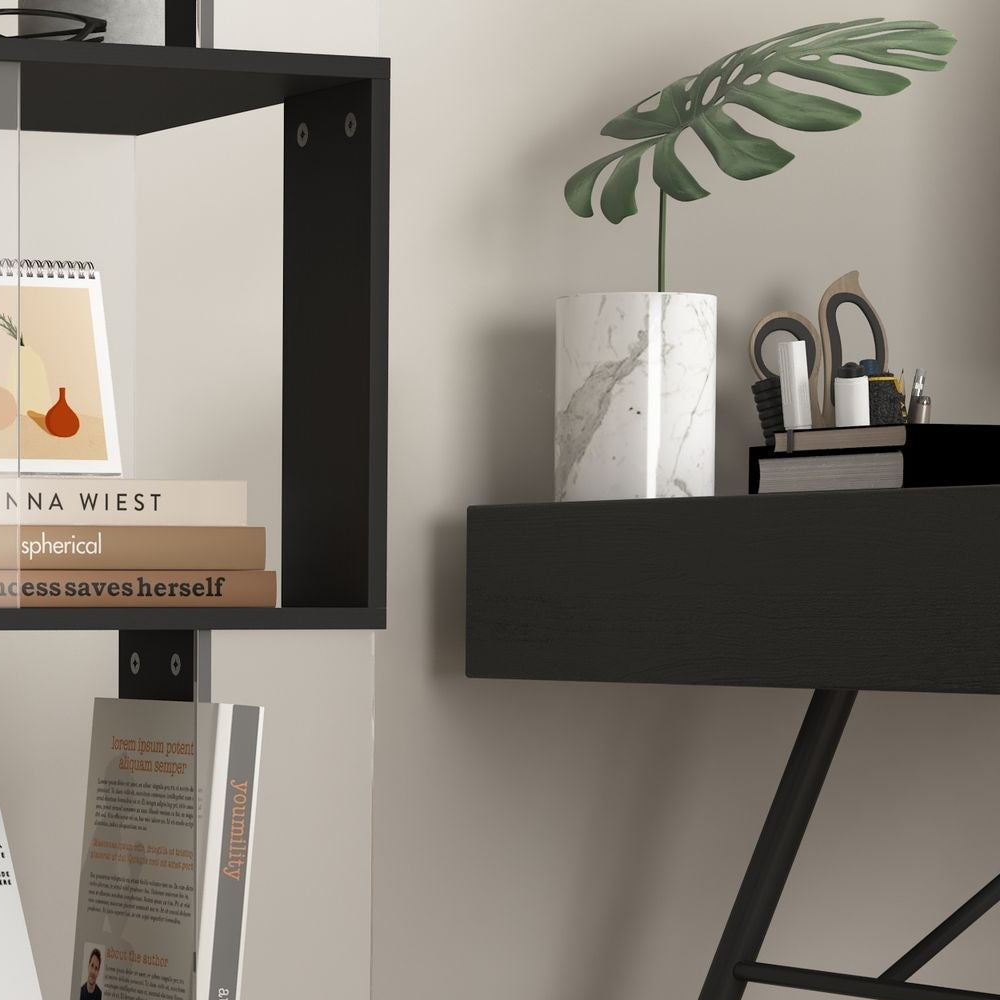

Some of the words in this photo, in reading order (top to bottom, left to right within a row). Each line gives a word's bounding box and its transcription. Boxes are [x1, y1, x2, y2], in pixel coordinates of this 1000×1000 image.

[79, 492, 161, 511] WIEST
[21, 531, 102, 560] spherical
[65, 582, 133, 598] saves
[136, 577, 225, 598] herself
[112, 736, 136, 752] lorem
[138, 738, 164, 756] ipsum
[154, 759, 188, 777] semper
[222, 779, 248, 880] youmility
[128, 949, 141, 964] the
[142, 952, 169, 968] author
